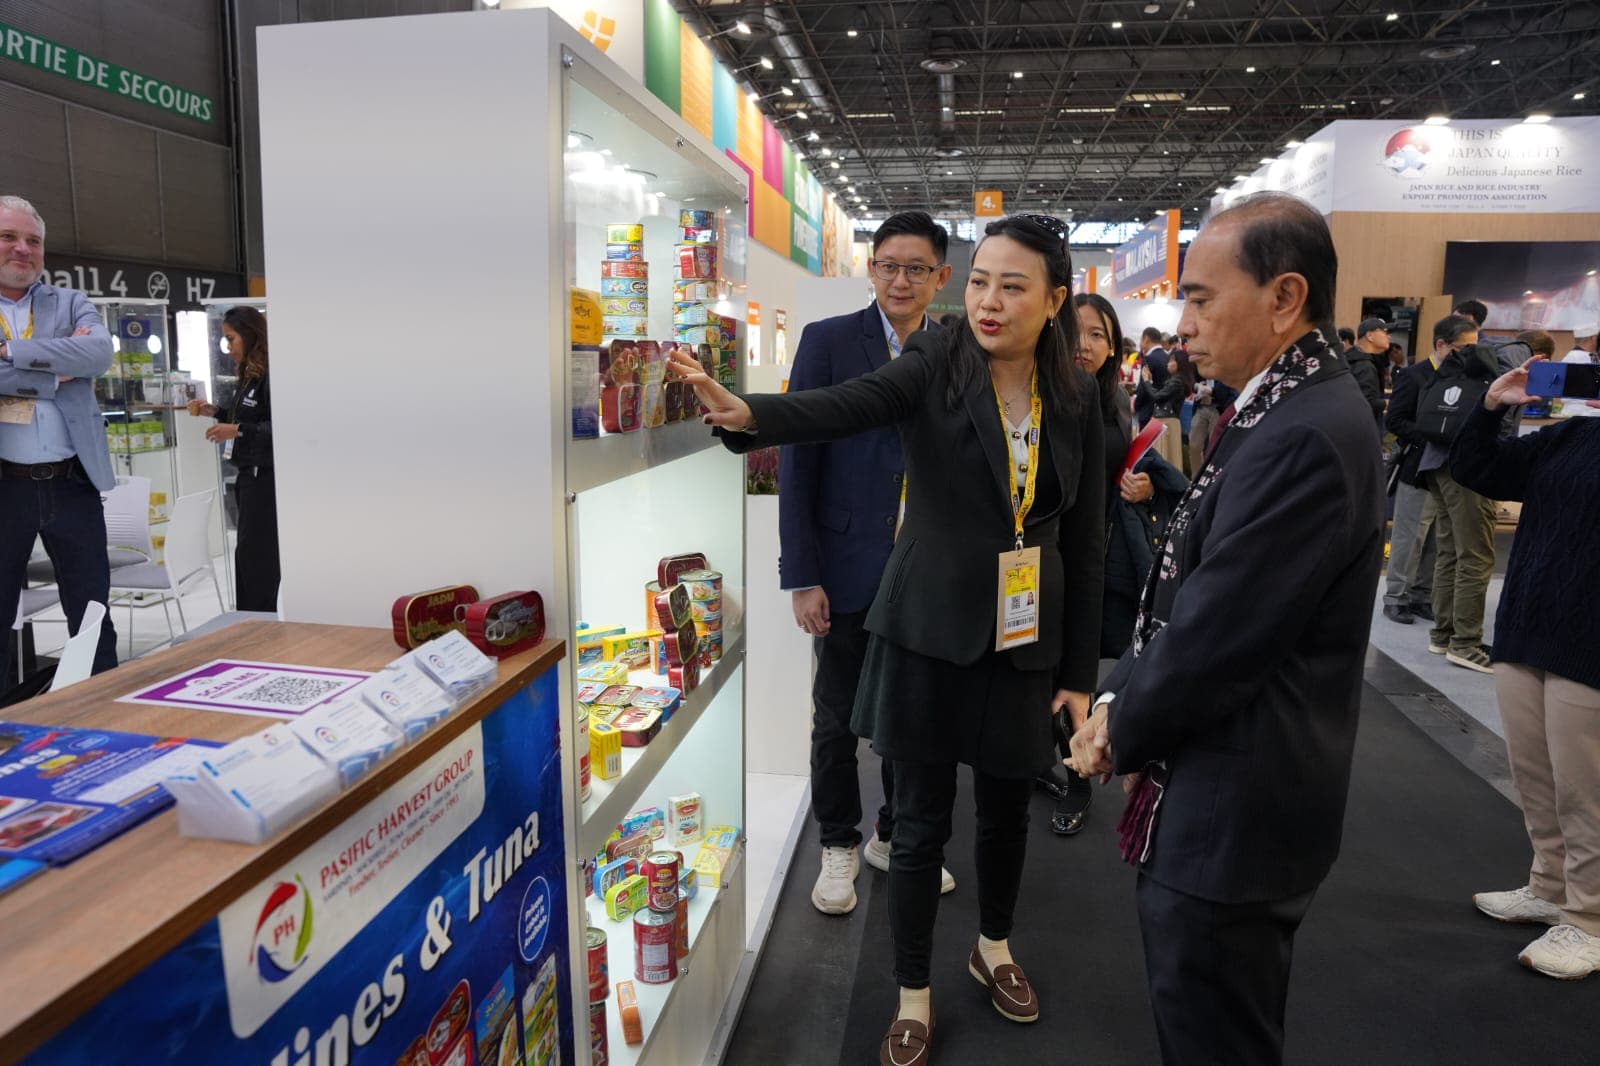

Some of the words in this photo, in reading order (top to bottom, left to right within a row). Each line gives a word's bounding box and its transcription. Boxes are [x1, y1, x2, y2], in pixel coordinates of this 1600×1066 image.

[77, 55, 109, 88] DE
[118, 70, 213, 121] SECOURS
[1447, 166, 1498, 177] Delicious
[1500, 167, 1552, 179] Japanese
[1556, 165, 1583, 176] Rice
[1457, 184, 1475, 192] AND
[1498, 184, 1542, 192] INDUSTRY
[1125, 233, 1158, 279] MALAYSIA
[109, 269, 129, 298] 4
[186, 276, 216, 302] H7
[319, 828, 375, 889] PASIFIC
[377, 781, 433, 841] HARVEST
[434, 748, 474, 792] GROUP
[271, 953, 405, 1066] ines
[420, 895, 452, 971] &
[464, 811, 540, 923] Tuna
[274, 914, 295, 947] PH
